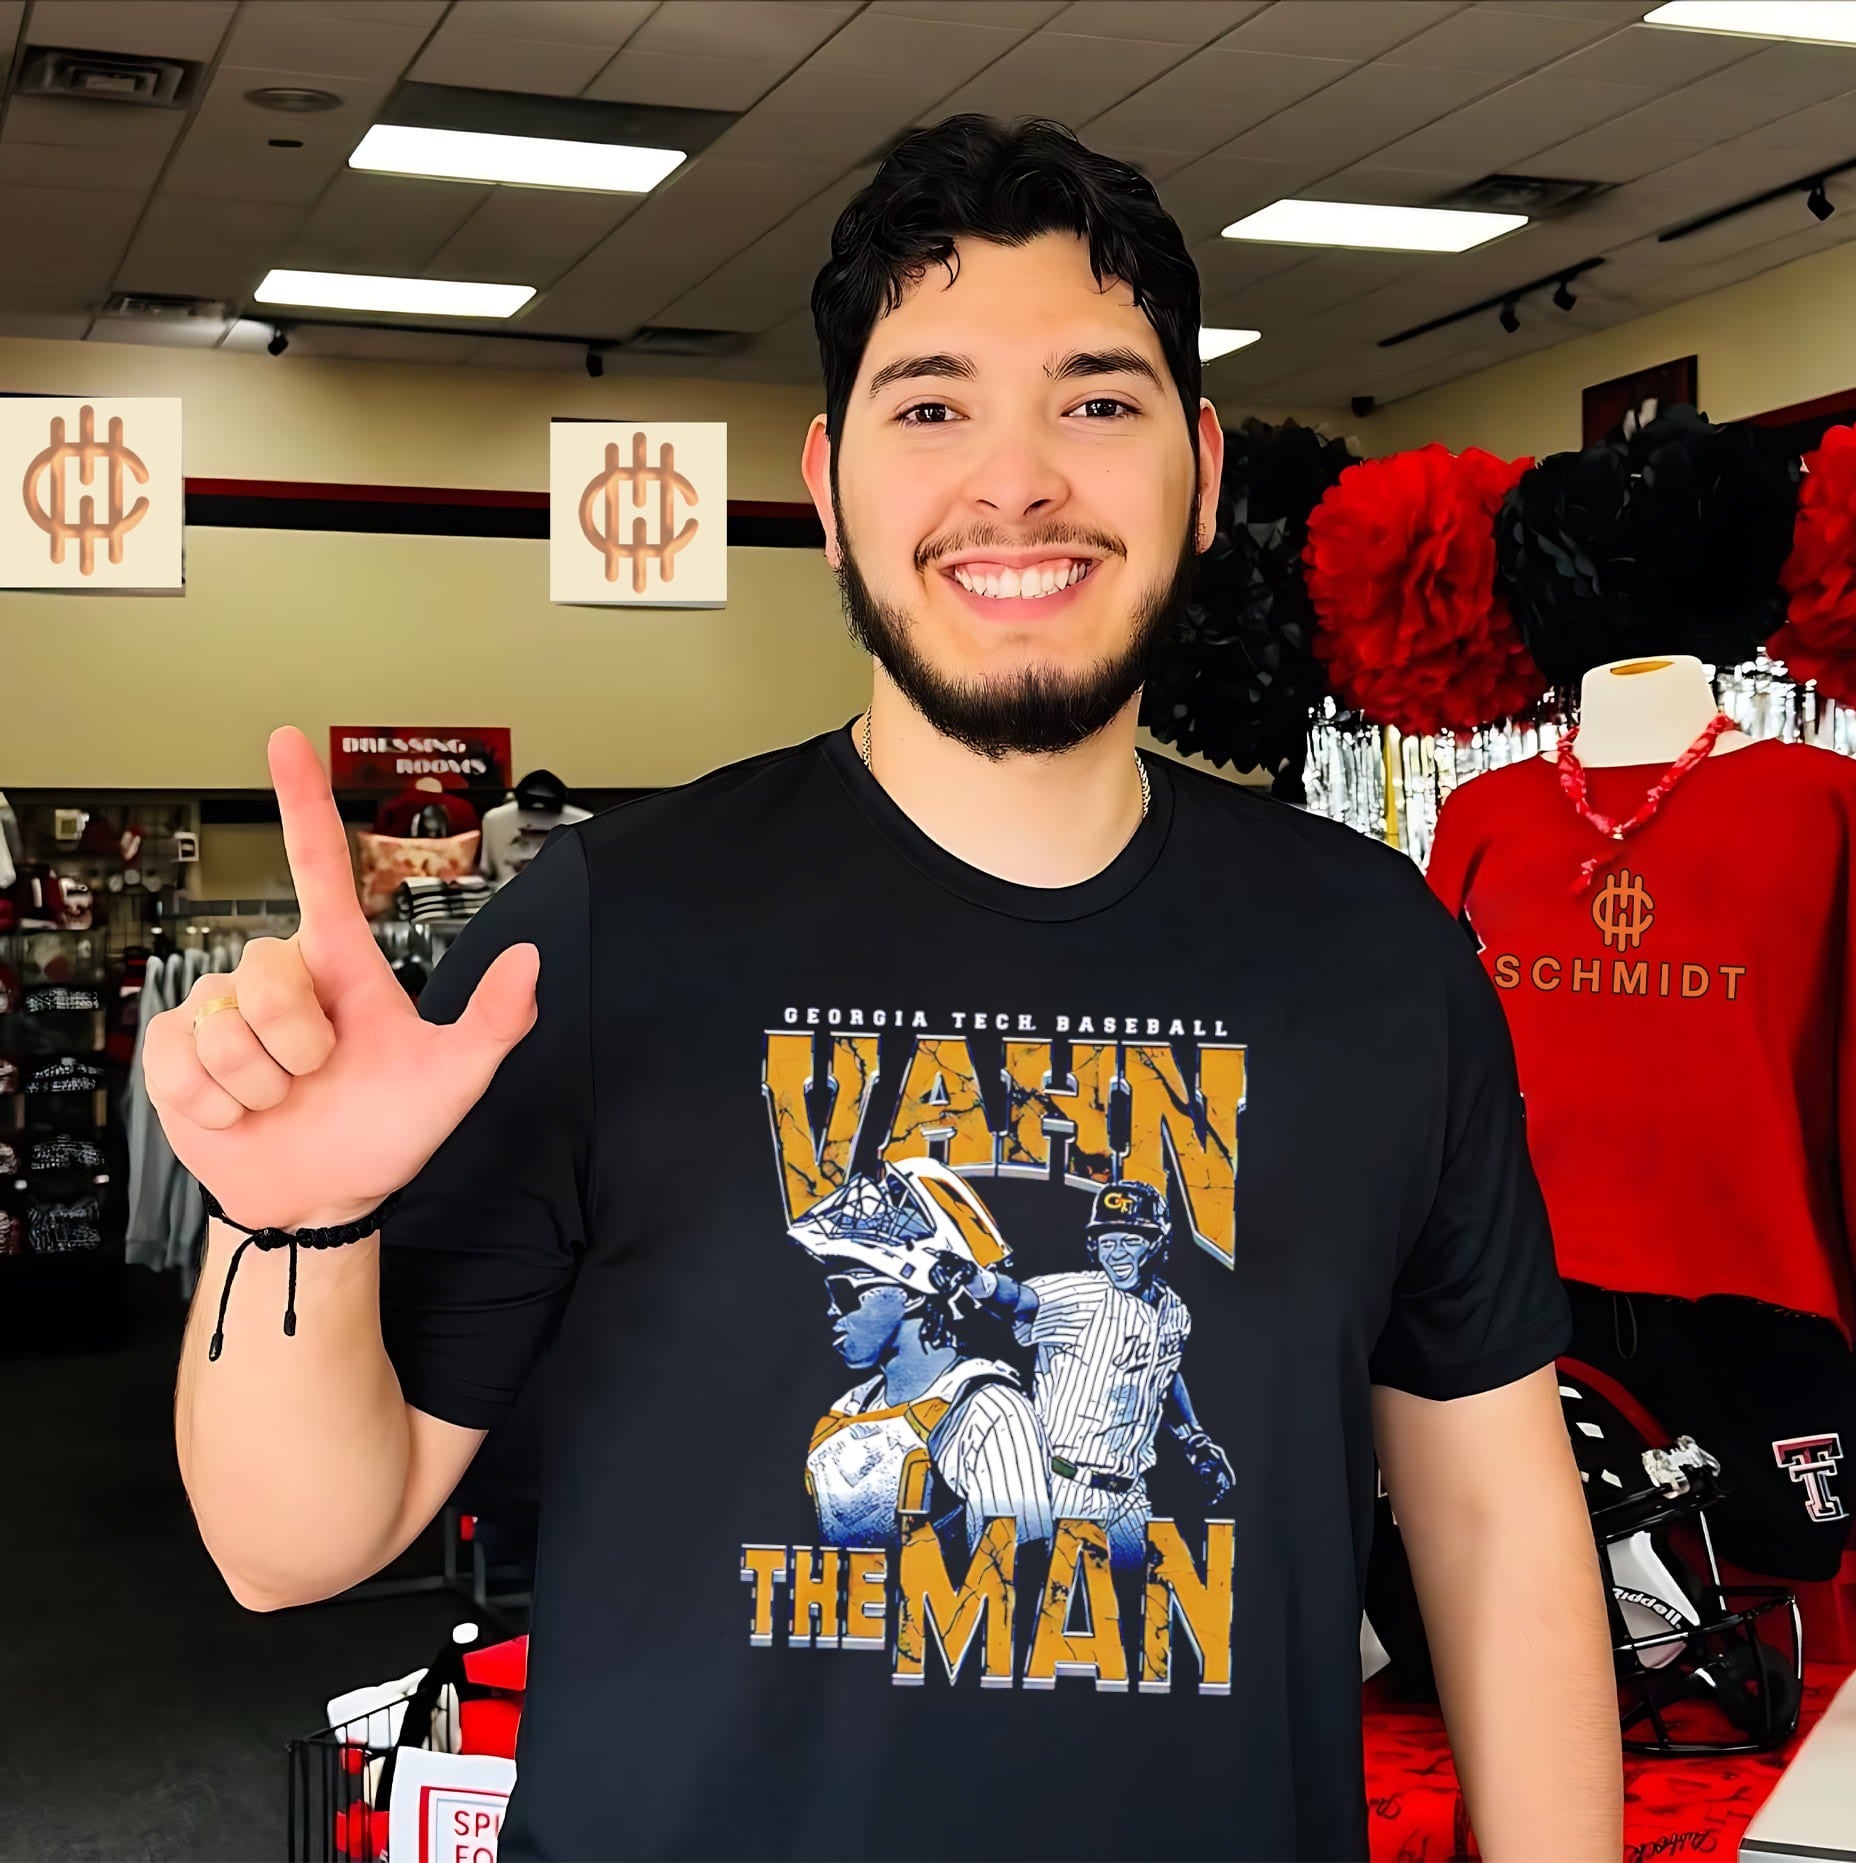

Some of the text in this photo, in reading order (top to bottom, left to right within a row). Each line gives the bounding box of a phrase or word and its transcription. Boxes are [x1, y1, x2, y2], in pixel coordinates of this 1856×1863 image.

[342, 737, 467, 754] DRESSING
[396, 758, 487, 775] ROOMS
[1494, 953, 1747, 1000] SCHMIDT
[784, 1007, 928, 1028] GEORGIA
[1056, 1015, 1228, 1037] BASEBALL
[761, 1030, 1249, 1271] VAHN
[740, 1514, 1235, 1696] THE MAN
